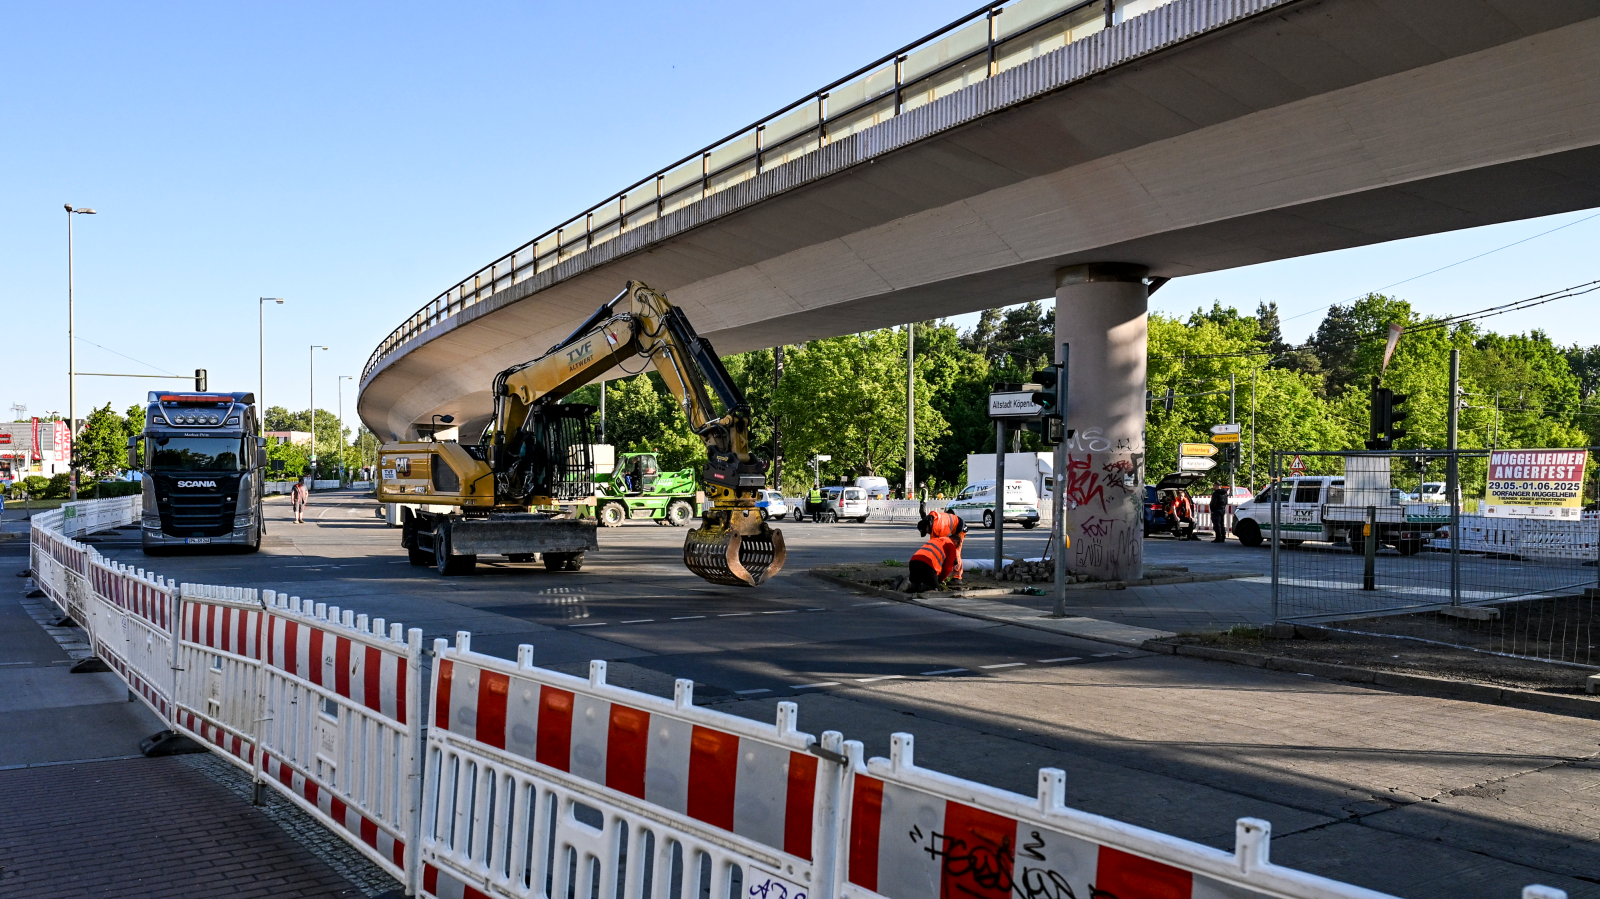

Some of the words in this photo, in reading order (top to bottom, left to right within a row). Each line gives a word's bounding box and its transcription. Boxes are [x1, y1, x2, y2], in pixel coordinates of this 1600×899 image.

[567, 341, 592, 361] TVF
[569, 354, 594, 372] ALTWERT
[993, 400, 1012, 409] Altstadt
[396, 458, 408, 472] CAT
[1491, 452, 1584, 465] MÜGGELHEIMER
[1495, 466, 1576, 479] ANGERFEST
[1488, 482, 1580, 491] 29.05.-01.06.2025
